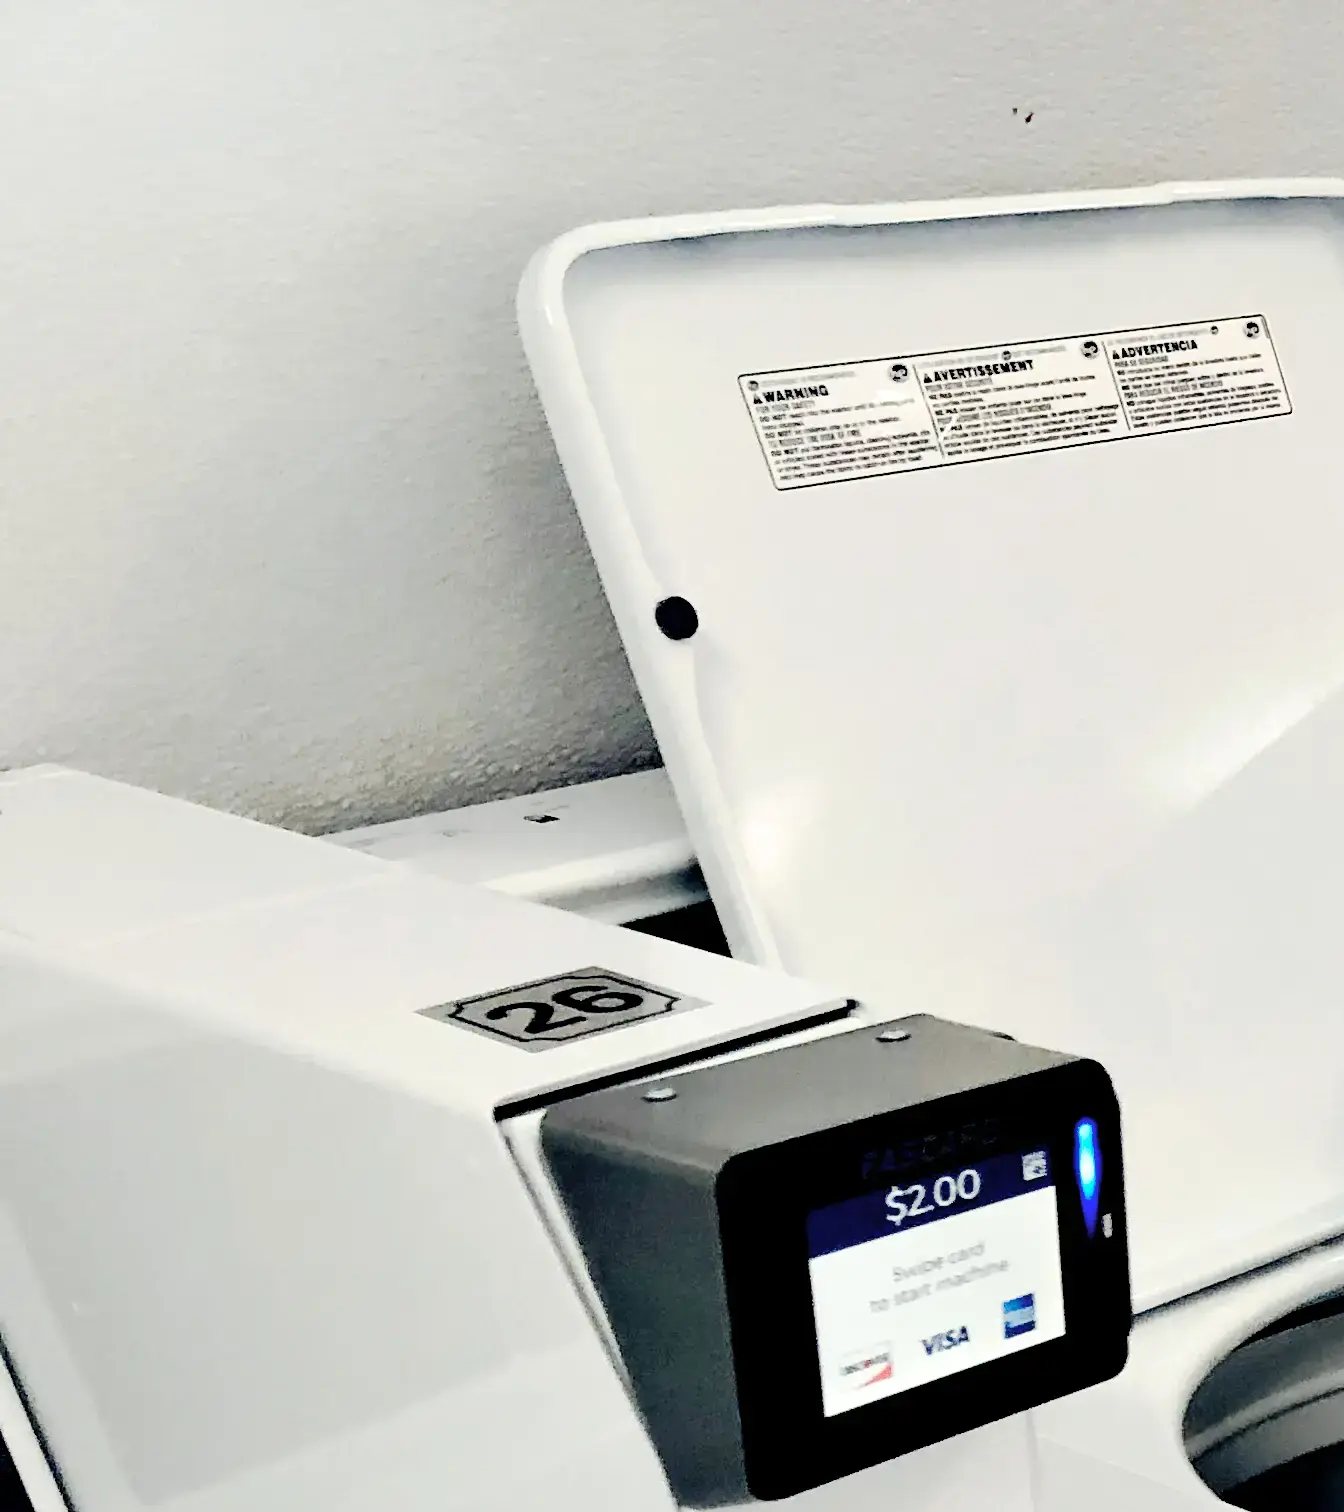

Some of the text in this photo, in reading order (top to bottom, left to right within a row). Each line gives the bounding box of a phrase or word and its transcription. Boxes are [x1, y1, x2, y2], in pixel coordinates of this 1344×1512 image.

[1121, 340, 1198, 358] ADVERTENCIA
[934, 359, 1034, 382] AVERTISSEMENT
[762, 385, 828, 402] WARNING
[485, 985, 644, 1034] 26
[885, 1169, 981, 1226] $2.00
[893, 1239, 985, 1282] Swipe card
[893, 1283, 931, 1306] start
[935, 1259, 1009, 1291] machine
[919, 1326, 970, 1355] VISA
